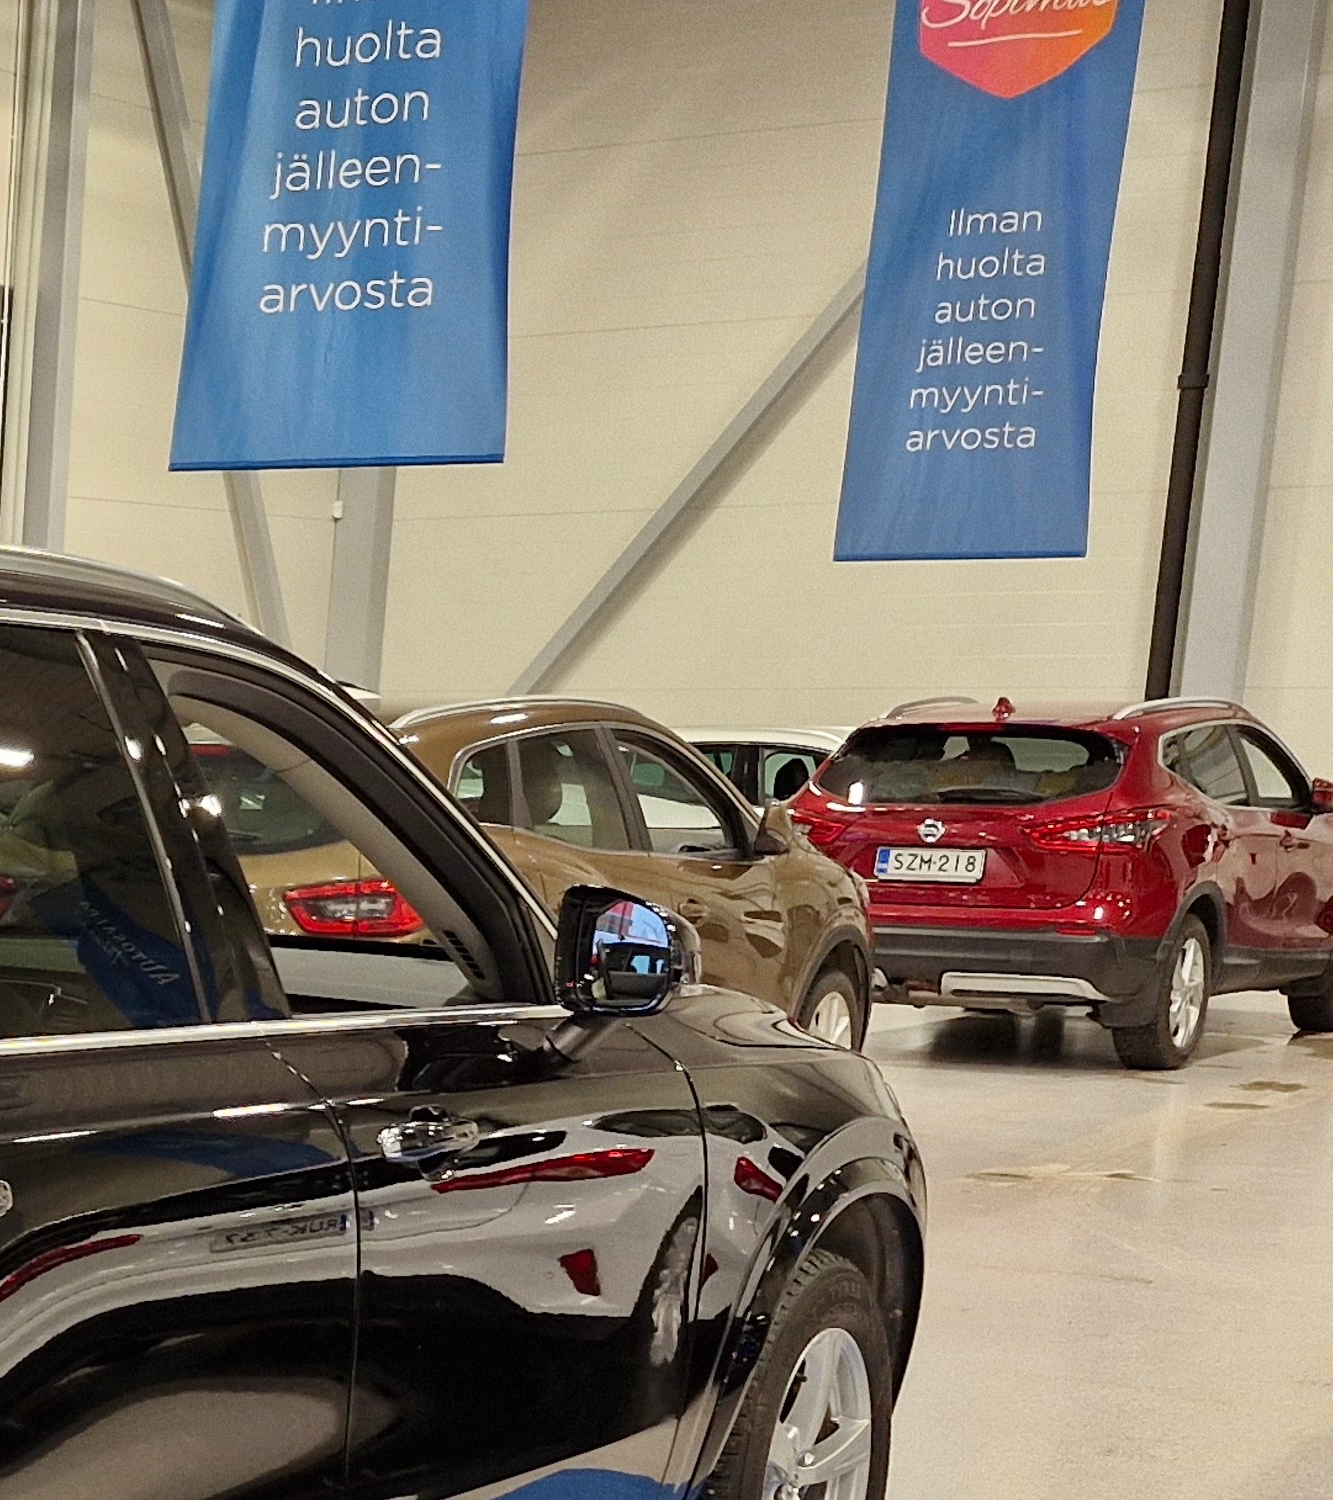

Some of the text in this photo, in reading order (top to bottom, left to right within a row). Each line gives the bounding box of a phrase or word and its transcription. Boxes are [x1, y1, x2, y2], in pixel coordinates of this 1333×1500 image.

[295, 19, 442, 67] huolta
[295, 87, 430, 130] auton
[269, 150, 442, 200] jälleen-
[262, 206, 443, 260] myynti-
[949, 207, 1042, 237] Ilman
[936, 247, 1046, 281] huolta
[259, 270, 434, 314] arvosta
[934, 294, 1035, 324] auton
[915, 336, 1045, 373] jälleen-
[909, 377, 1045, 414] myynti-
[905, 421, 1036, 452] arvosta
[893, 853, 977, 873] SZM-218
